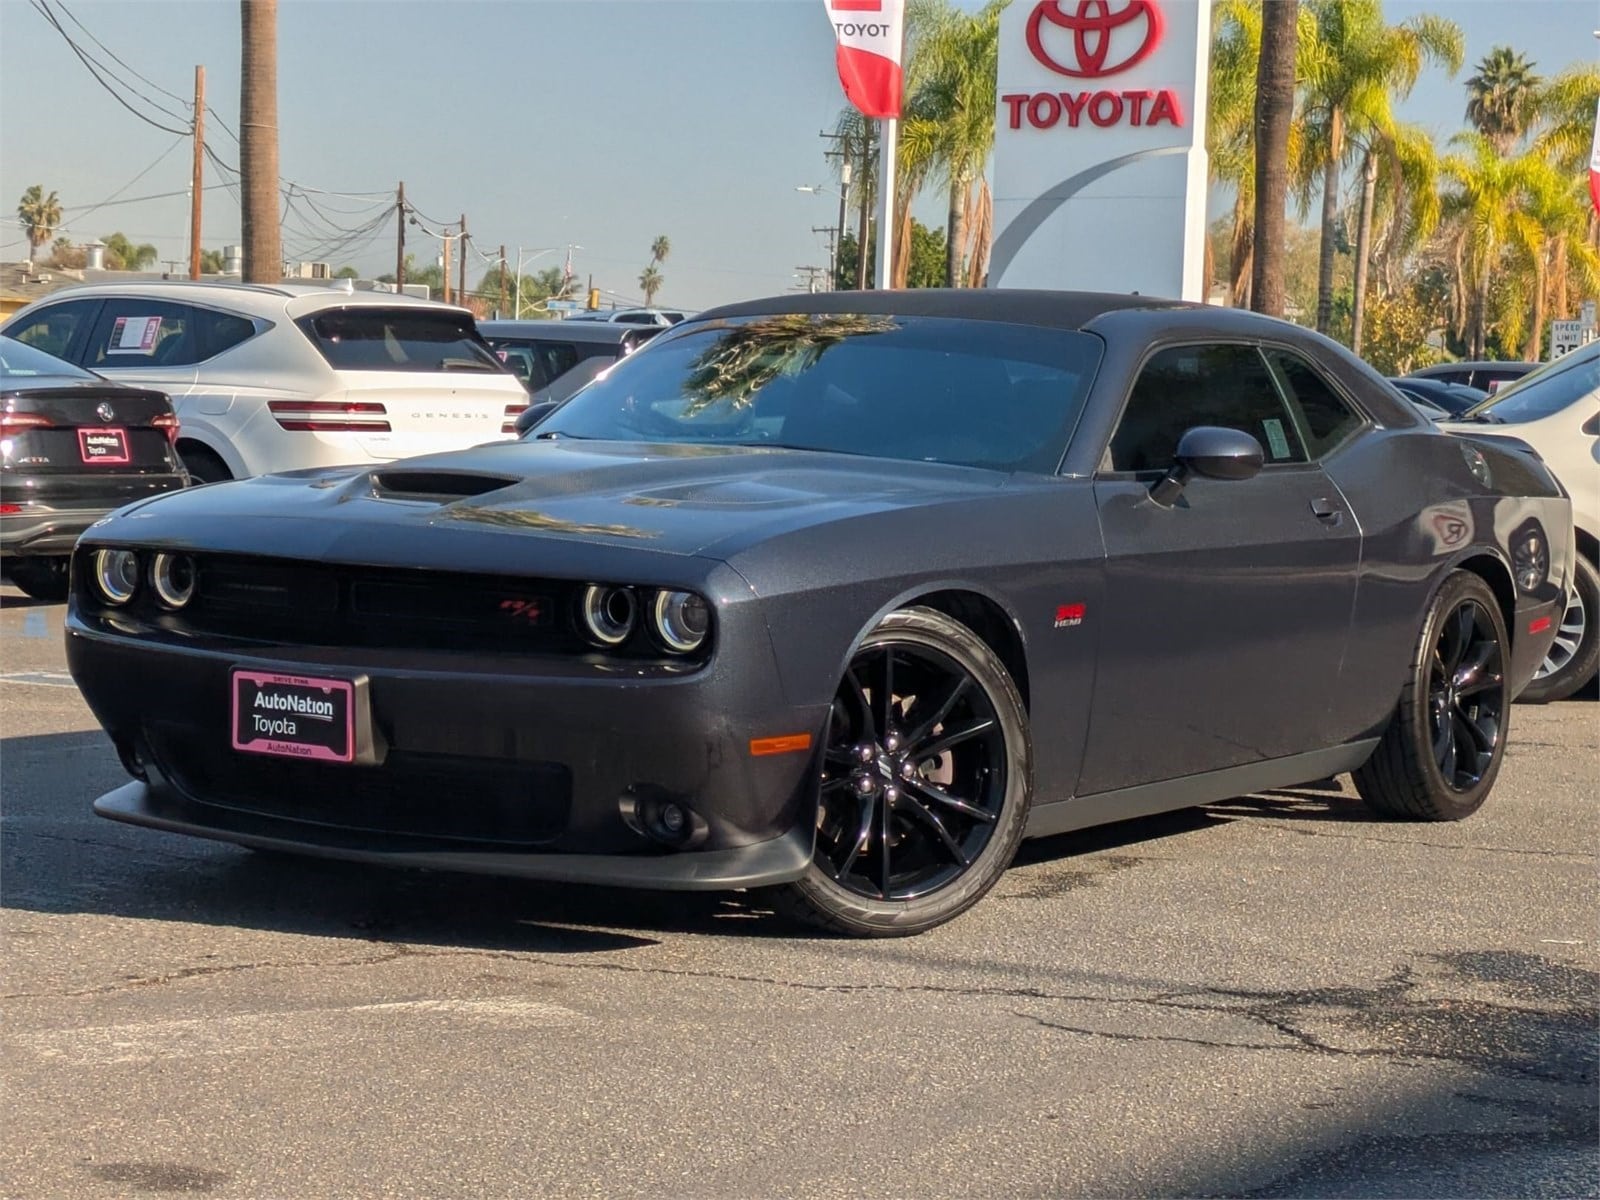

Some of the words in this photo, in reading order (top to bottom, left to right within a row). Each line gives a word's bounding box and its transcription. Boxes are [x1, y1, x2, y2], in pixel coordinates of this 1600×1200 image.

[1001, 89, 1183, 129] TOYOTA
[1555, 323, 1580, 331] SPEED
[87, 446, 107, 455] Toyota
[254, 691, 334, 716] AutoNation
[252, 714, 297, 736] Toyota
[267, 742, 313, 755] AutoNation
